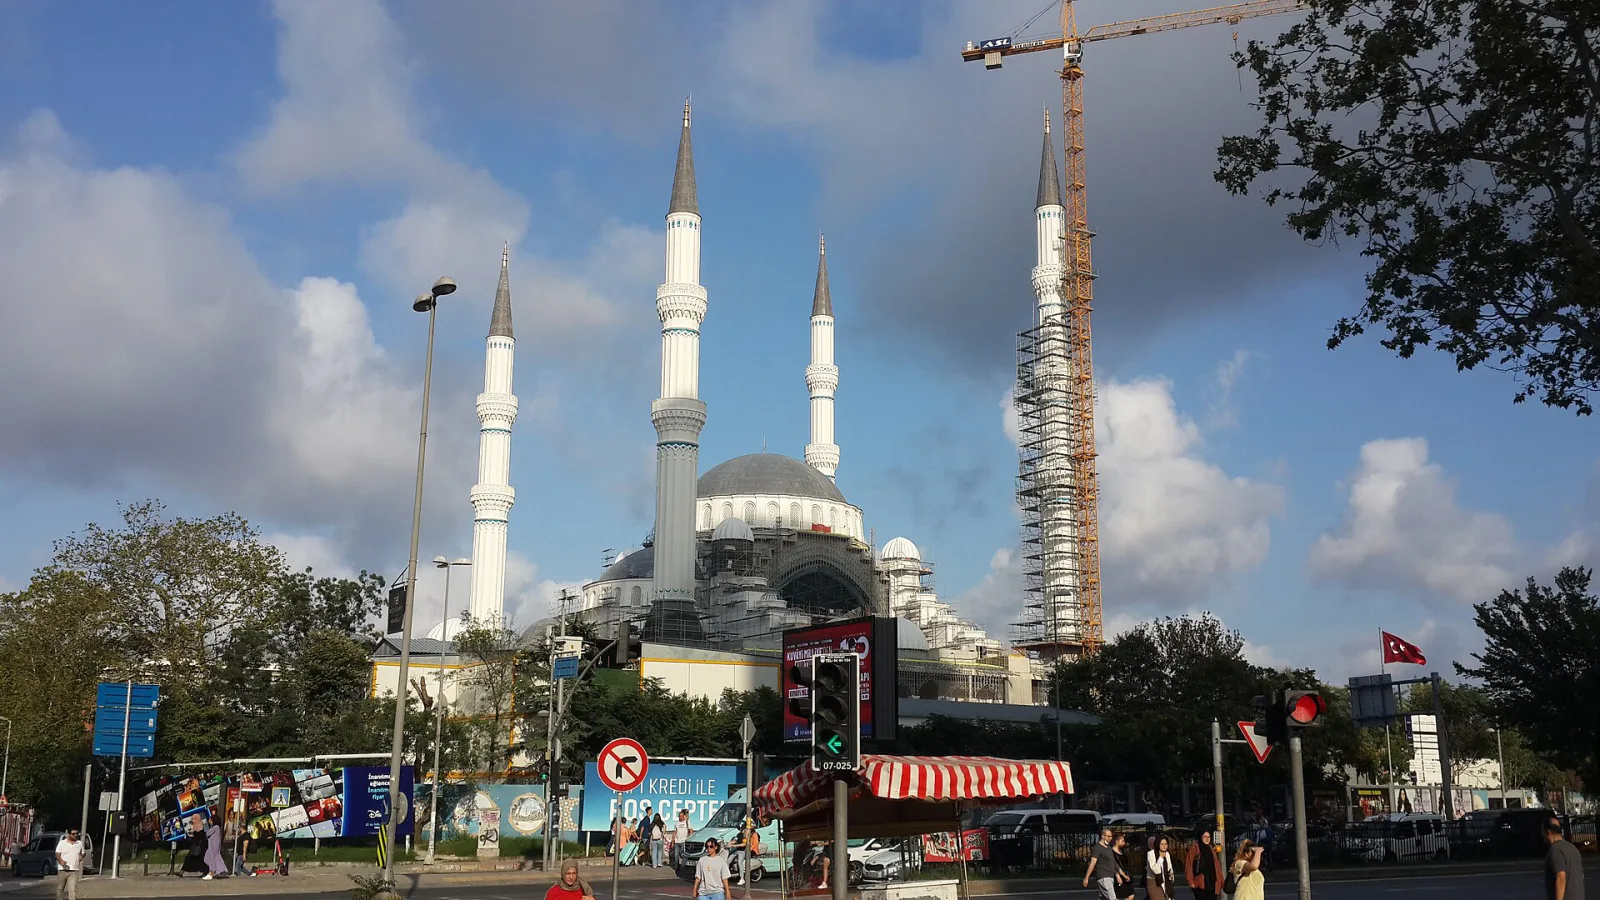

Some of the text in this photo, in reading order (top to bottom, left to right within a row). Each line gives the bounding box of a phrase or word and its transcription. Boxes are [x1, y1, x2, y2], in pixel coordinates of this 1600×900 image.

[982, 38, 1010, 48] ASL
[823, 761, 852, 770] 07-025
[658, 799, 725, 822] CEPTE
